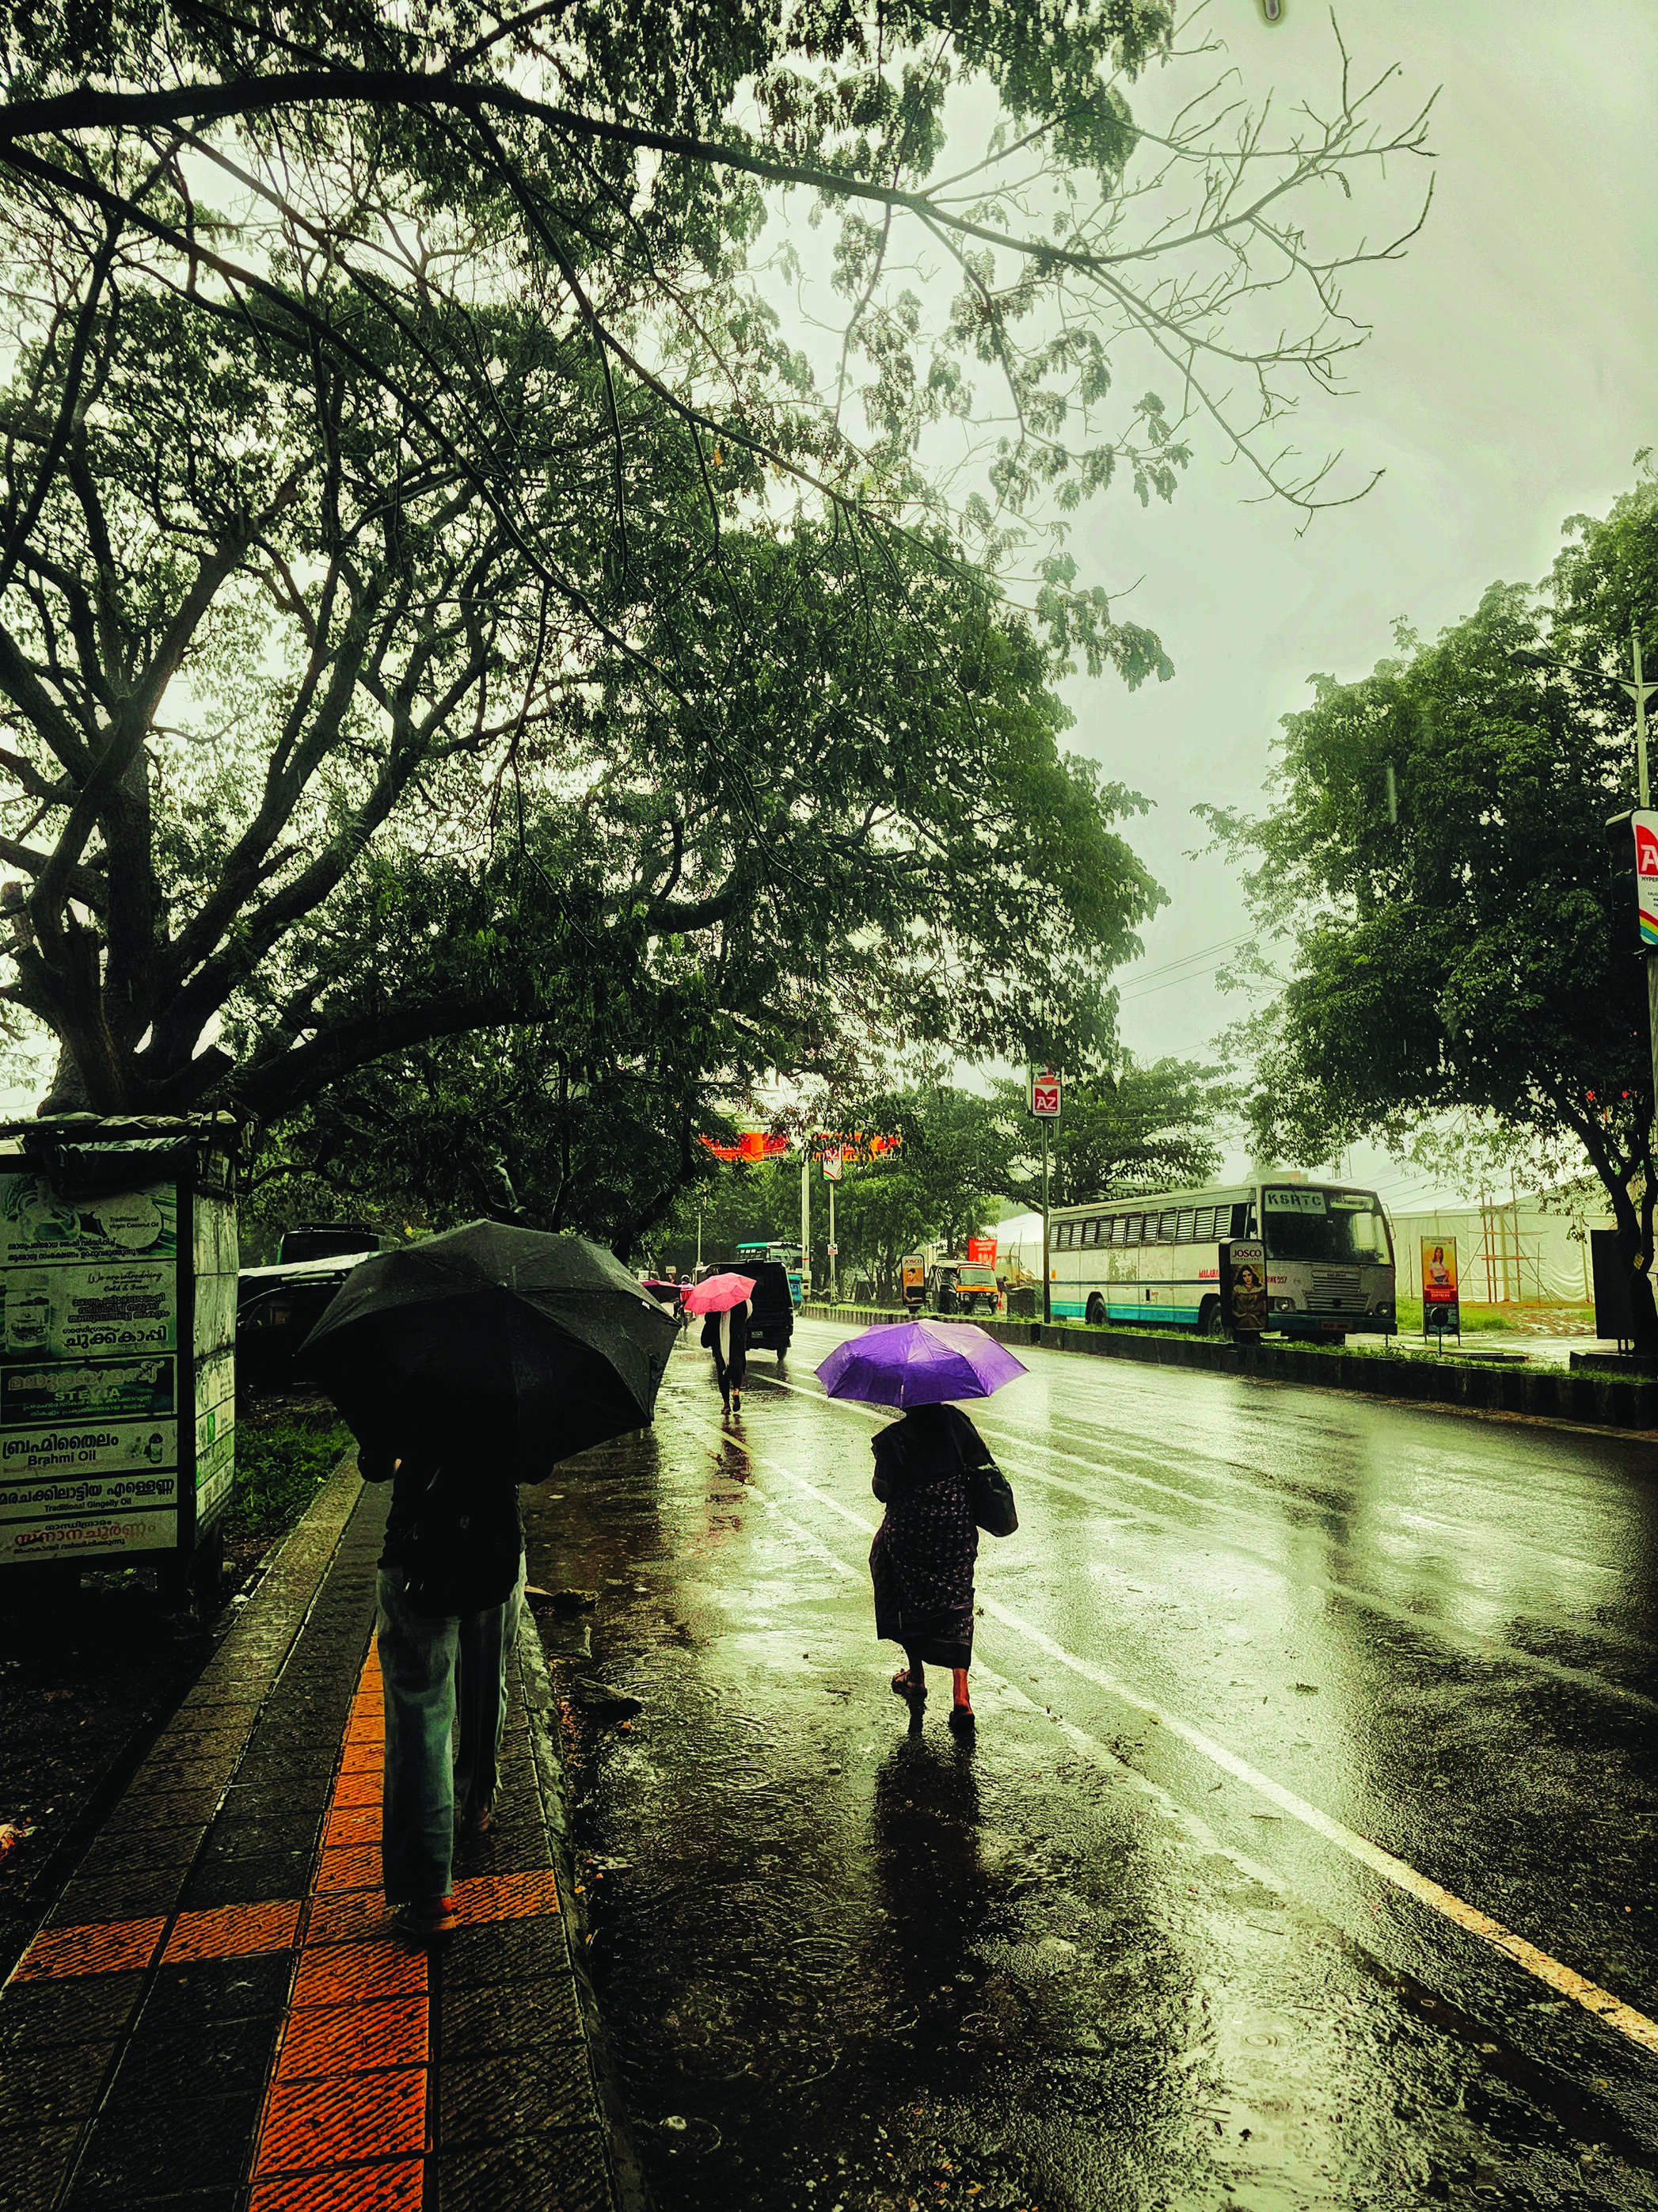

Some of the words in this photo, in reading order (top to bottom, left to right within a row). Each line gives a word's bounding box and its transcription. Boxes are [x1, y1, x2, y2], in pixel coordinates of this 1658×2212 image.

[1036, 1096, 1056, 1110] AZ
[1268, 1194, 1321, 1206] KSRTC
[29, 1452, 74, 1466] Brahmi
[78, 1450, 96, 1461] Oil
[44, 1502, 85, 1512] Traditional
[87, 1499, 119, 1509] Gingelly
